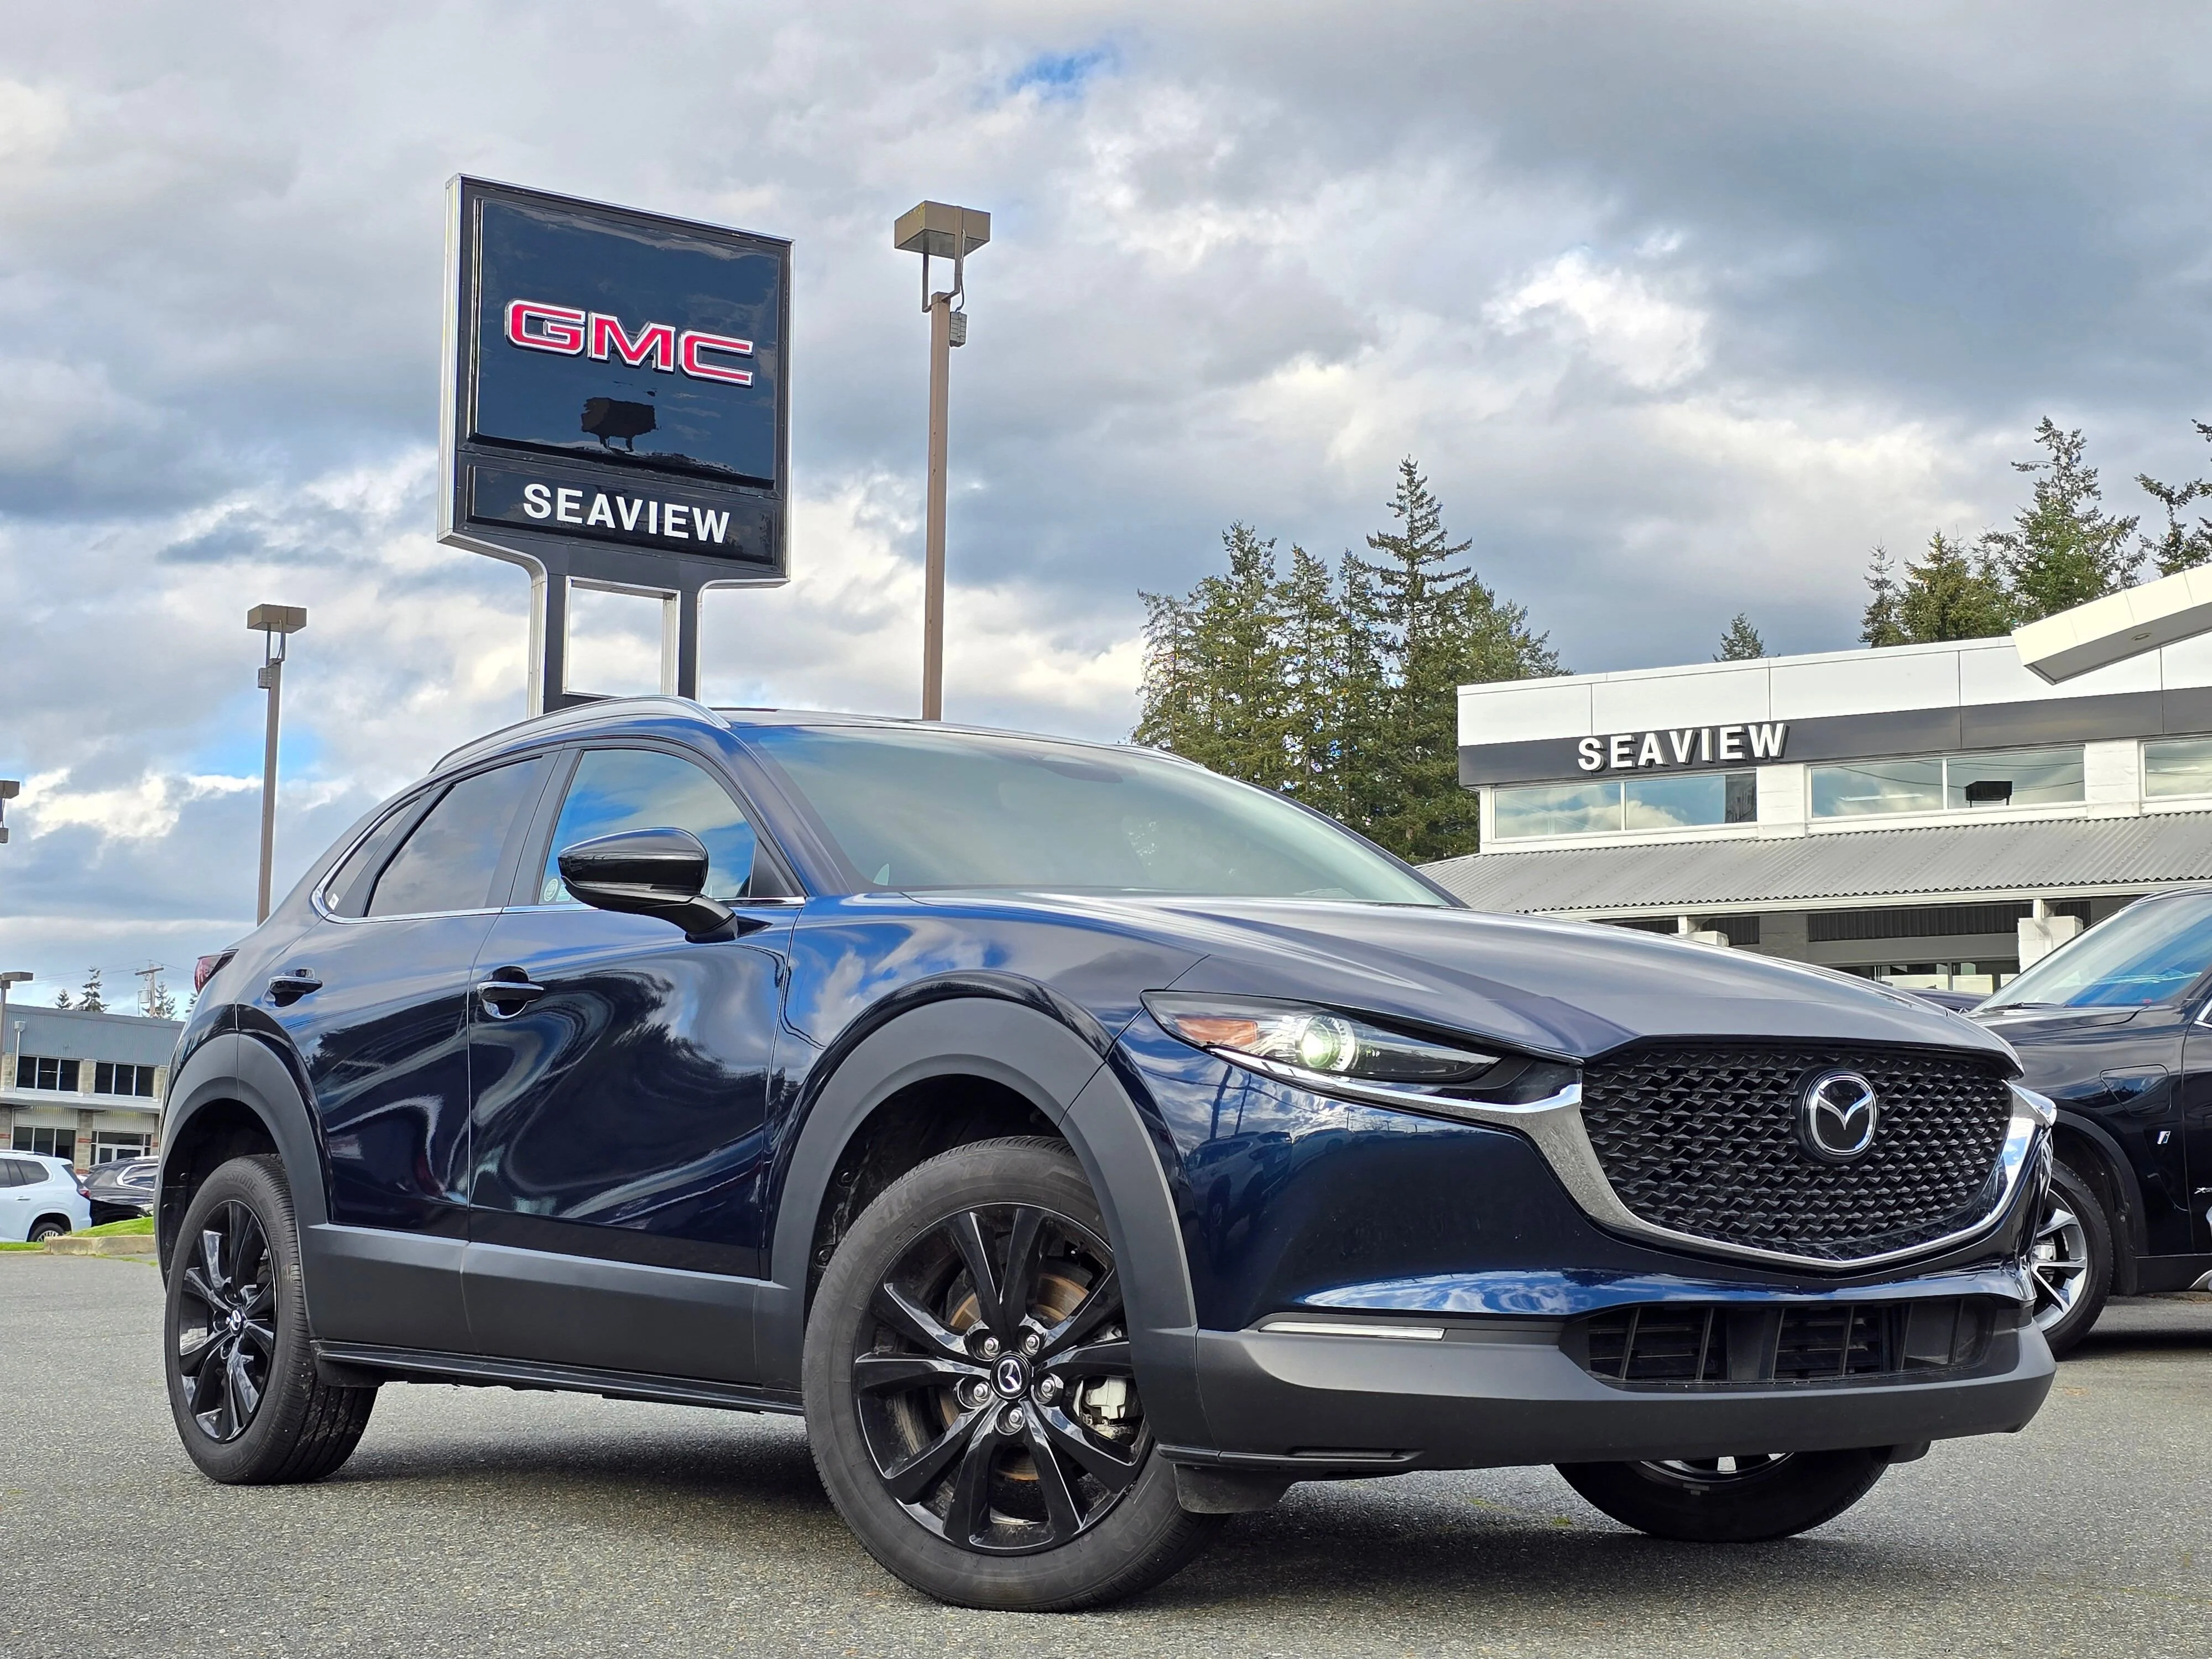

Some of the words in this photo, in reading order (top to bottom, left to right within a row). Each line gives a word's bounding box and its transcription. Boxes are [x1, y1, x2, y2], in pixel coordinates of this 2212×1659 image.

[505, 299, 753, 387] GMC
[523, 483, 729, 543] SEAVIEW
[1577, 723, 1787, 772] SEAVIEW
